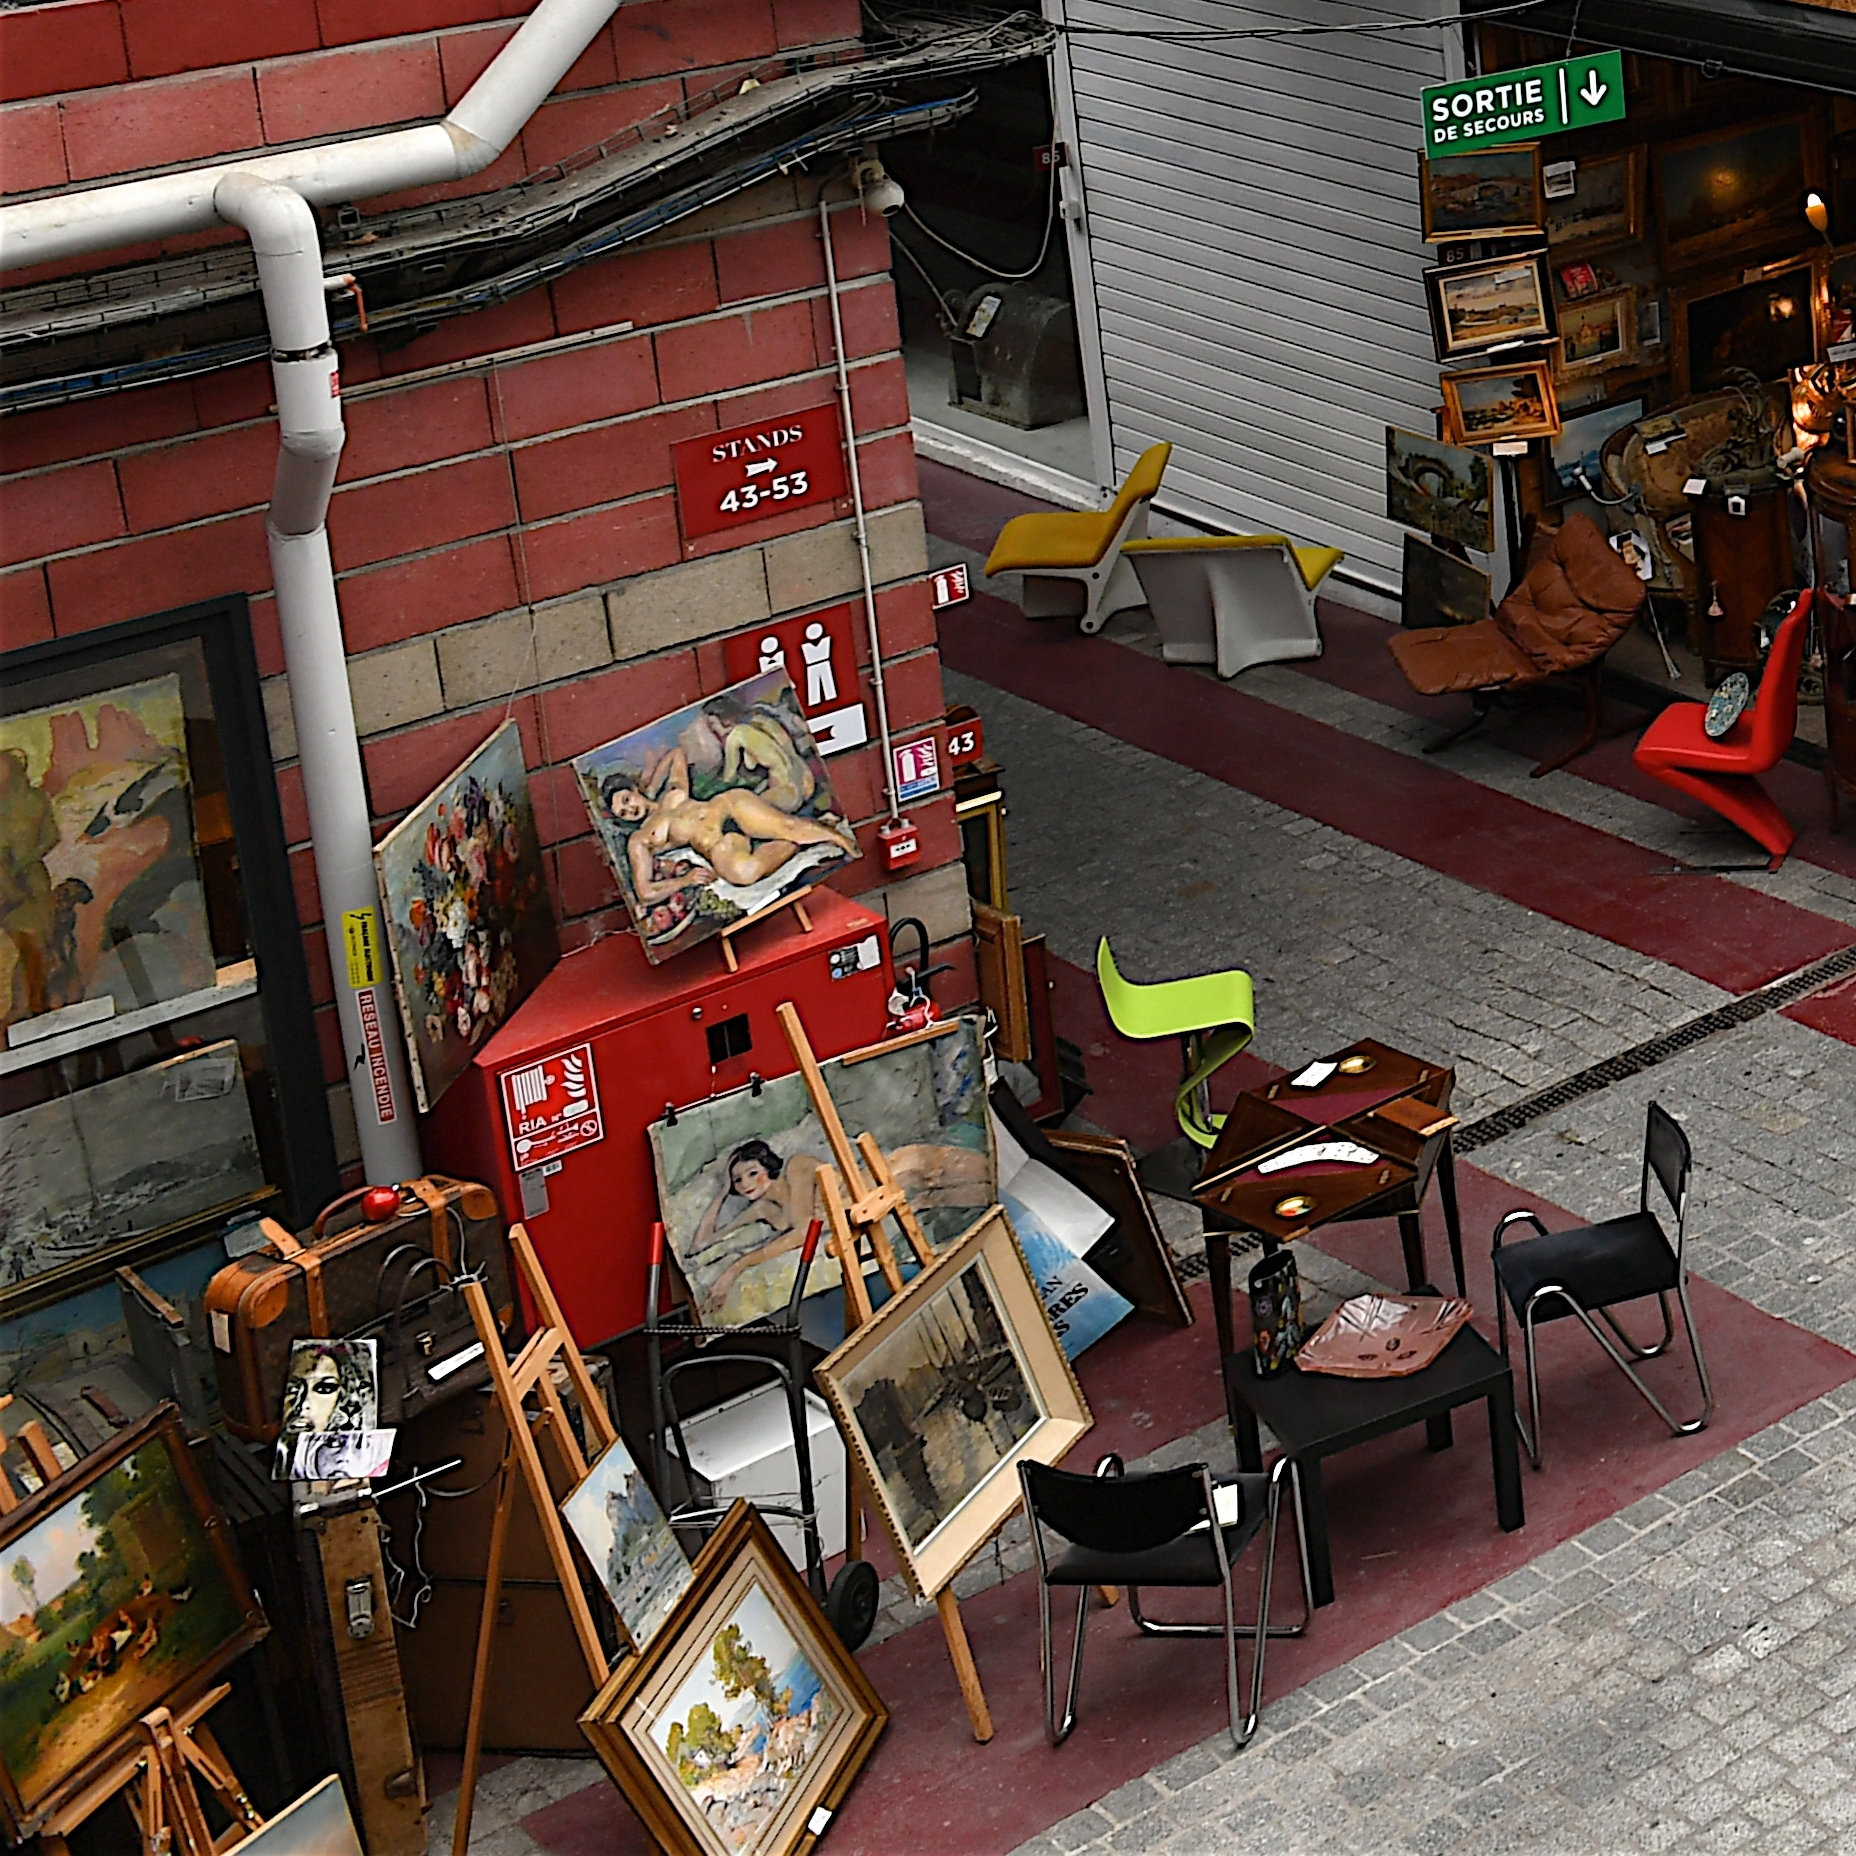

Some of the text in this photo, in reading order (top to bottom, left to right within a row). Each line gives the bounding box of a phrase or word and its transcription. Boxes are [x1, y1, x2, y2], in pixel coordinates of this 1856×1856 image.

[1432, 79, 1543, 122] SORTIE
[1433, 108, 1545, 144] DE SECOURS
[1446, 247, 1465, 263] 85
[712, 424, 803, 463] STANDS
[719, 470, 809, 513] 43-53
[948, 731, 975, 756] 43
[360, 993, 394, 1119] RESEAU INCENDIE
[519, 1116, 548, 1135] RIA
